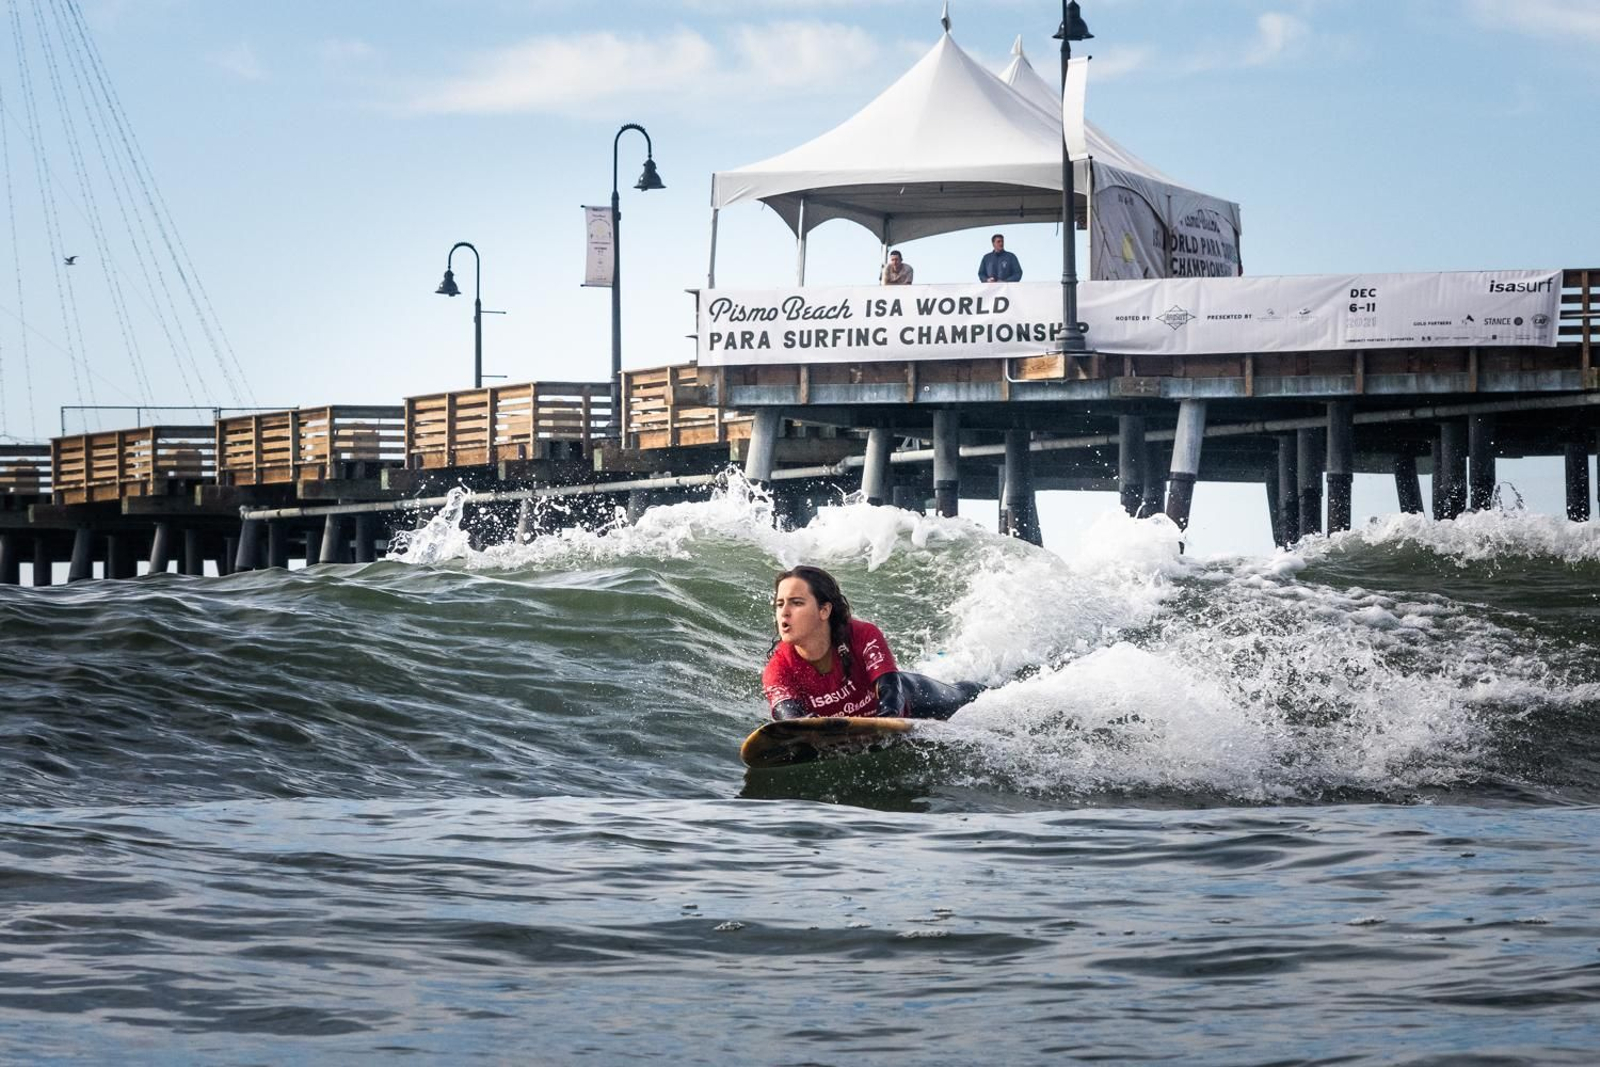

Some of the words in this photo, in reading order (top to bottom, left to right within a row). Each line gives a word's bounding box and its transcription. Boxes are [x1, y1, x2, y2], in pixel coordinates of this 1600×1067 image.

[1349, 288, 1377, 298] DEC
[1489, 277, 1554, 294] isasurf
[708, 297, 779, 323] Pismo
[781, 295, 853, 322] Beach
[865, 298, 904, 318] ISA
[916, 296, 1010, 316] WORLD
[1348, 302, 1376, 312] 6-11
[1484, 317, 1511, 326] STANCE
[709, 330, 771, 351] PARA
[783, 327, 888, 348] SURFING
[899, 321, 1090, 345] CHAMPIONSHP
[808, 680, 857, 708] isasurf
